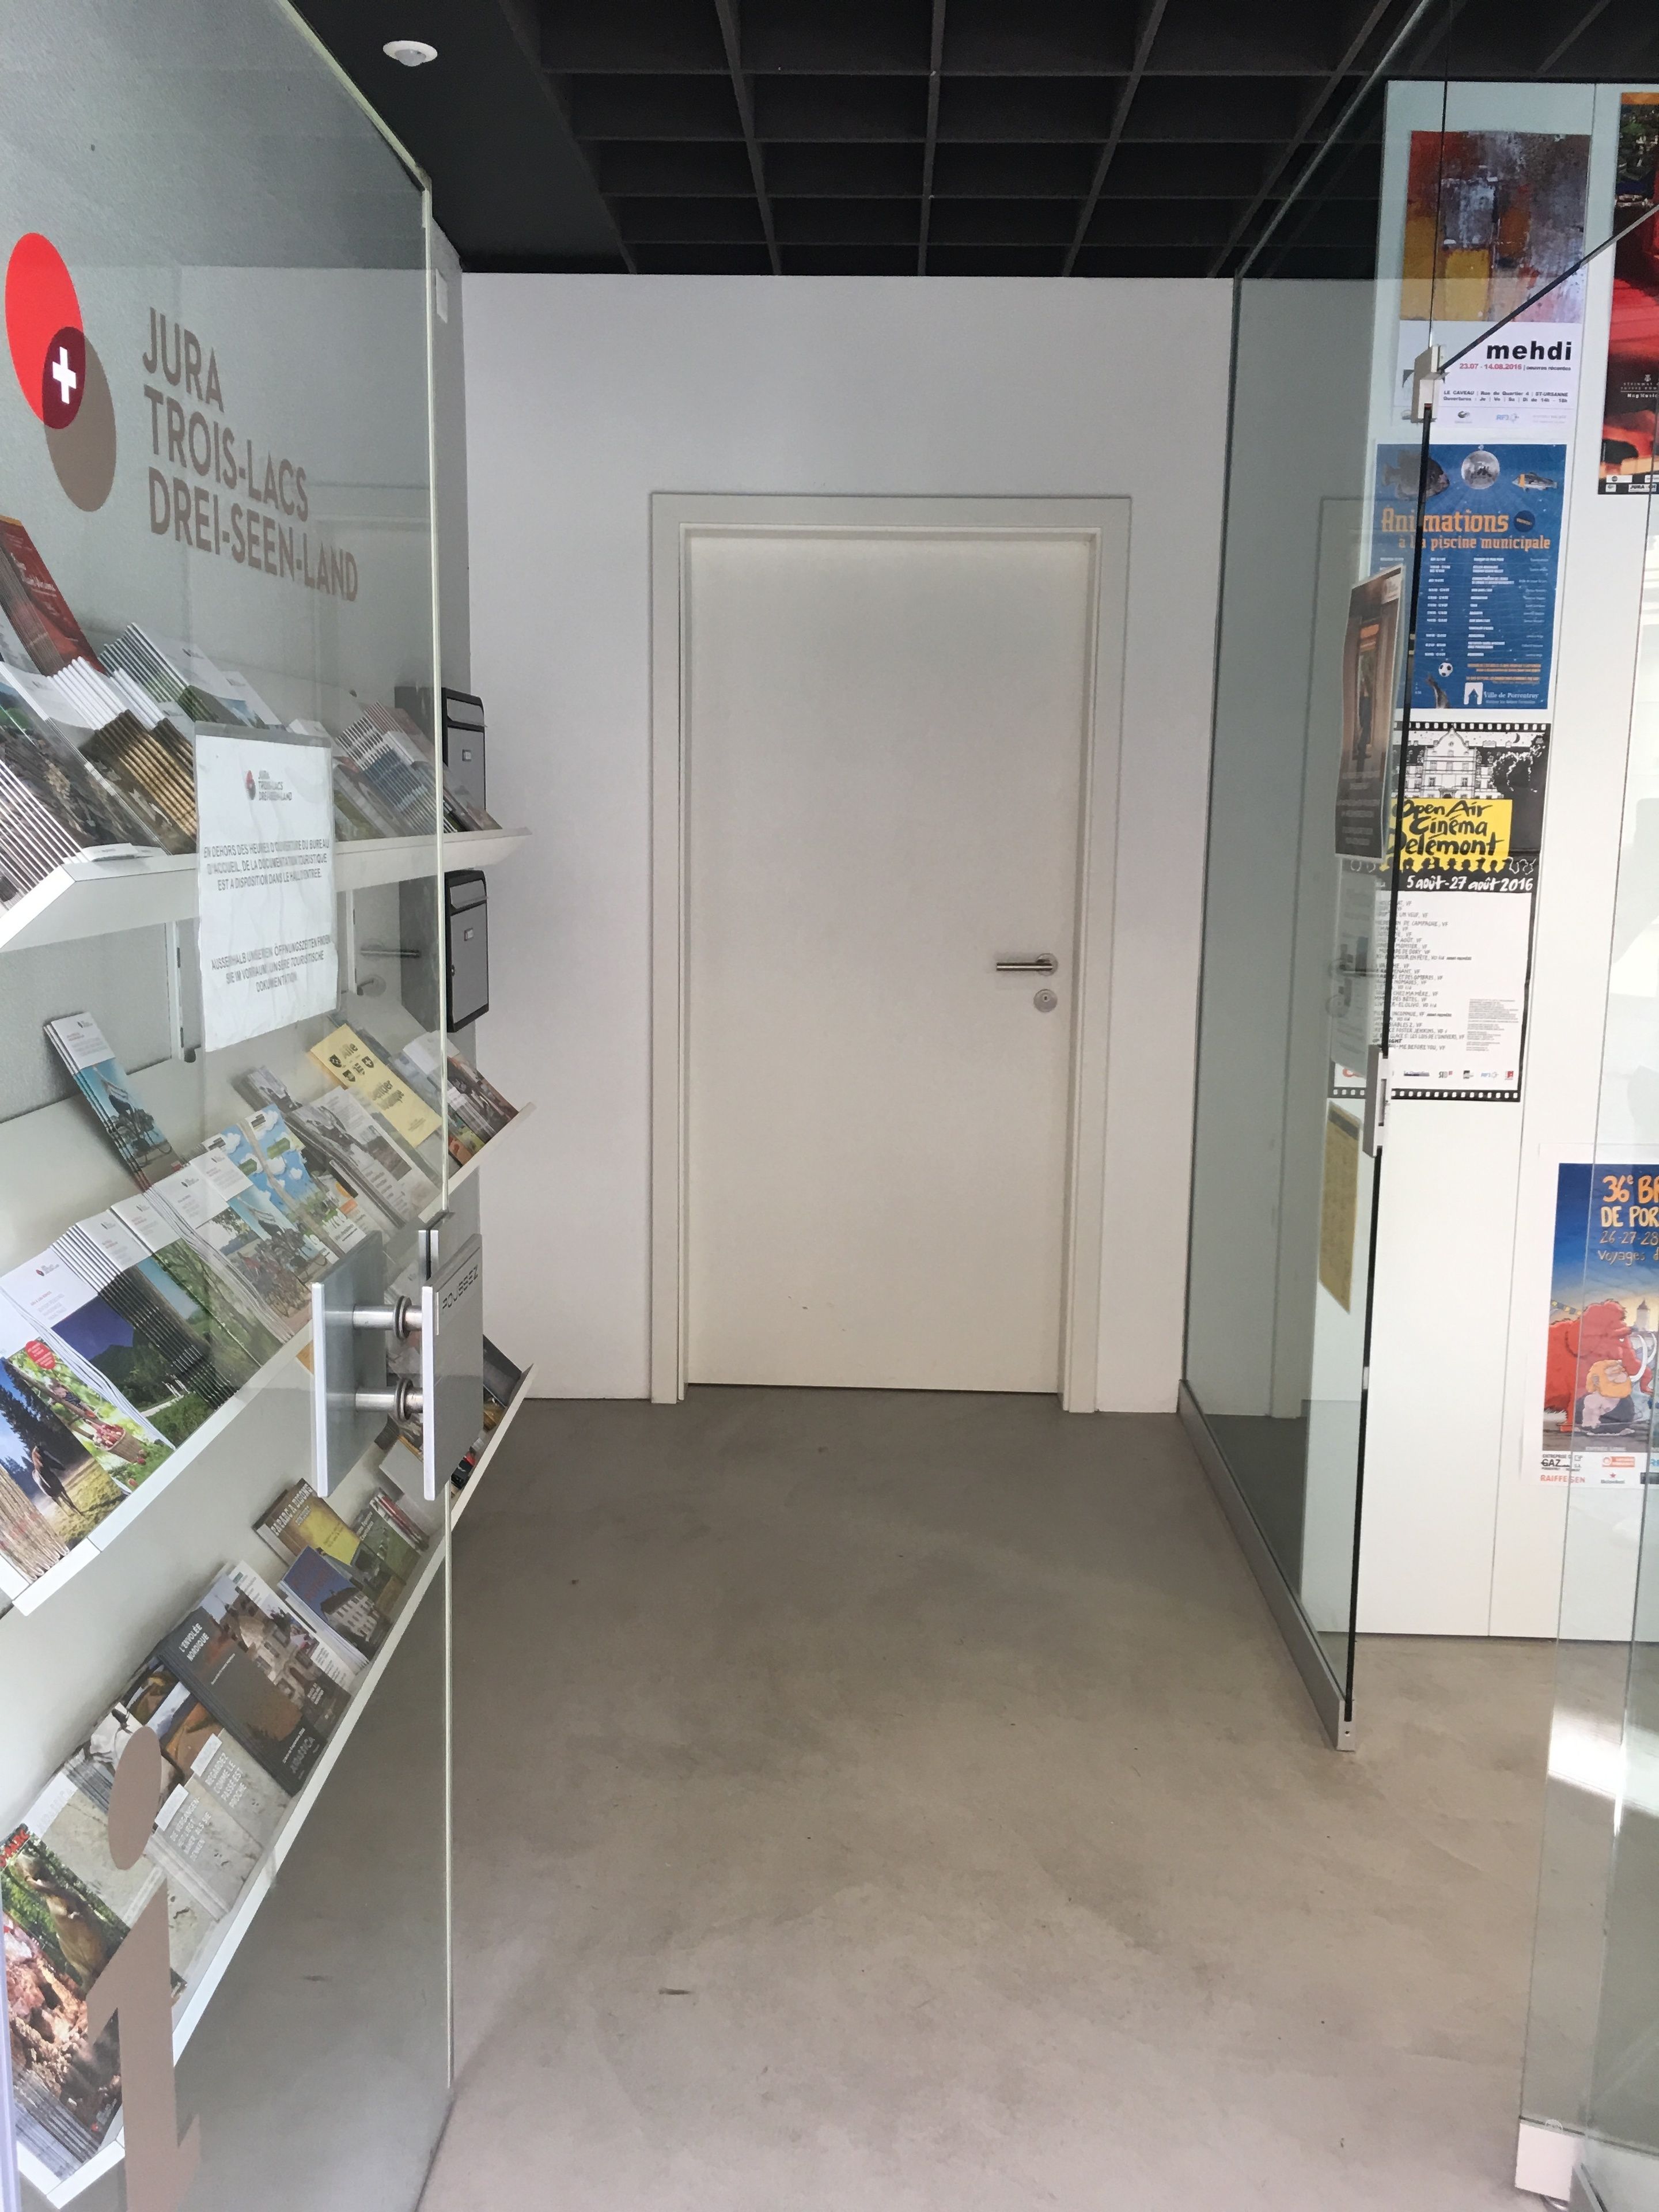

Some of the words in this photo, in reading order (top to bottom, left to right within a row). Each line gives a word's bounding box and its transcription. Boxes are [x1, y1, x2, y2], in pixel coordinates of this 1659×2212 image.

[142, 307, 224, 412] JURA
[1487, 341, 1571, 360] mehdi
[143, 384, 308, 521] TROIS-LACS
[1382, 507, 1509, 533] Animations
[149, 466, 358, 601] DREI-SEEN-LAND
[1431, 535, 1476, 551] piscine
[1481, 535, 1550, 551] municipale
[1392, 800, 1445, 821] Open
[1445, 800, 1493, 817] Air
[1409, 814, 1487, 836] Cinéma
[212, 844, 237, 857] DEHORS
[237, 843, 249, 855] DES
[243, 860, 250, 872] DE
[252, 859, 258, 870] LA
[1407, 876, 1415, 888] 5
[1468, 876, 1499, 891] août
[1498, 877, 1533, 891] 2016
[1601, 1206, 1623, 1228] DE
[1629, 1206, 1659, 1228] POR
[1541, 1459, 1561, 1467] GAZ
[1540, 1475, 1586, 1483] RAIFFESEN
[178, 1621, 203, 1653] L'ENVOLÉE
[187, 1632, 210, 1661] NORDIQUE
[204, 1752, 229, 1787] REGARDEZ
[213, 1769, 230, 1794] COMME
